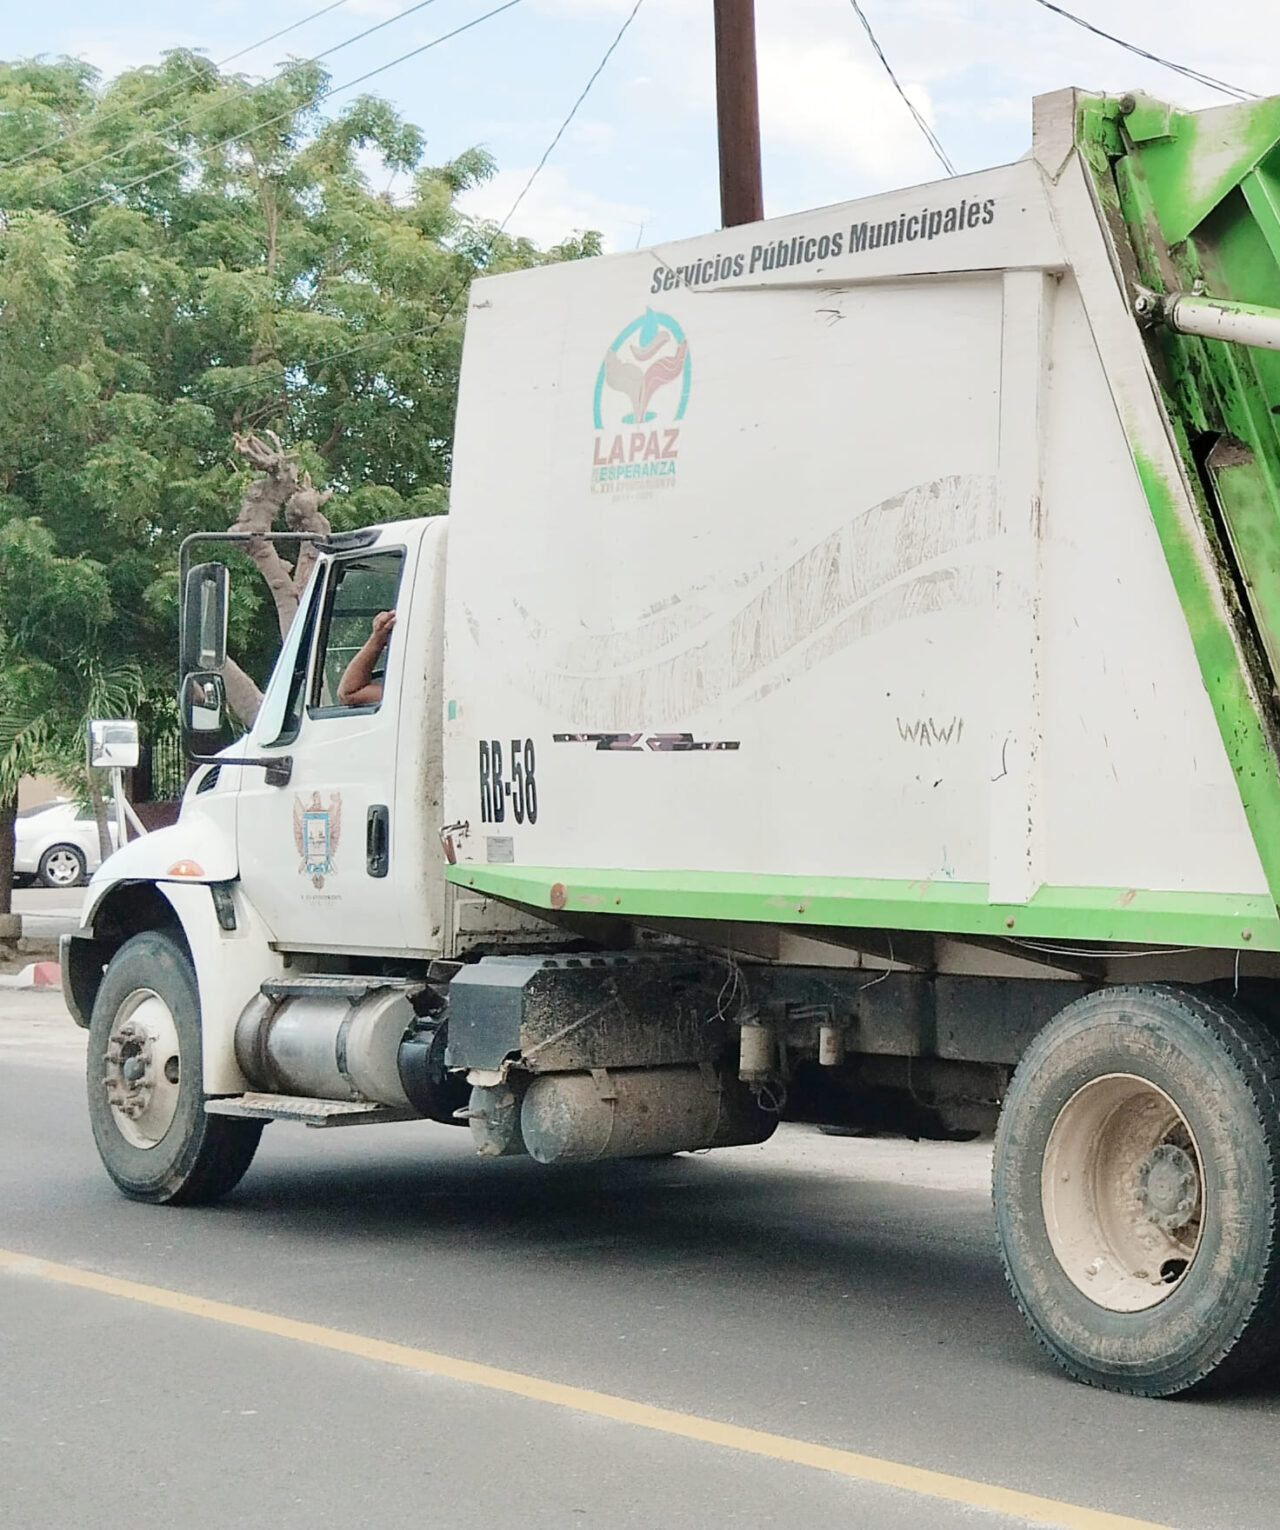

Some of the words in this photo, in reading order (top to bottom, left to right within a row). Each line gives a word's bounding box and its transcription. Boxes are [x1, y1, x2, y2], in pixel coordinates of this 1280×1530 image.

[650, 253, 745, 294] Servicios
[749, 231, 843, 274] Públicos
[592, 435, 626, 466] LA
[628, 428, 680, 462] PAZ
[599, 459, 677, 482] ESPERANZA
[479, 738, 538, 825] RB-58
